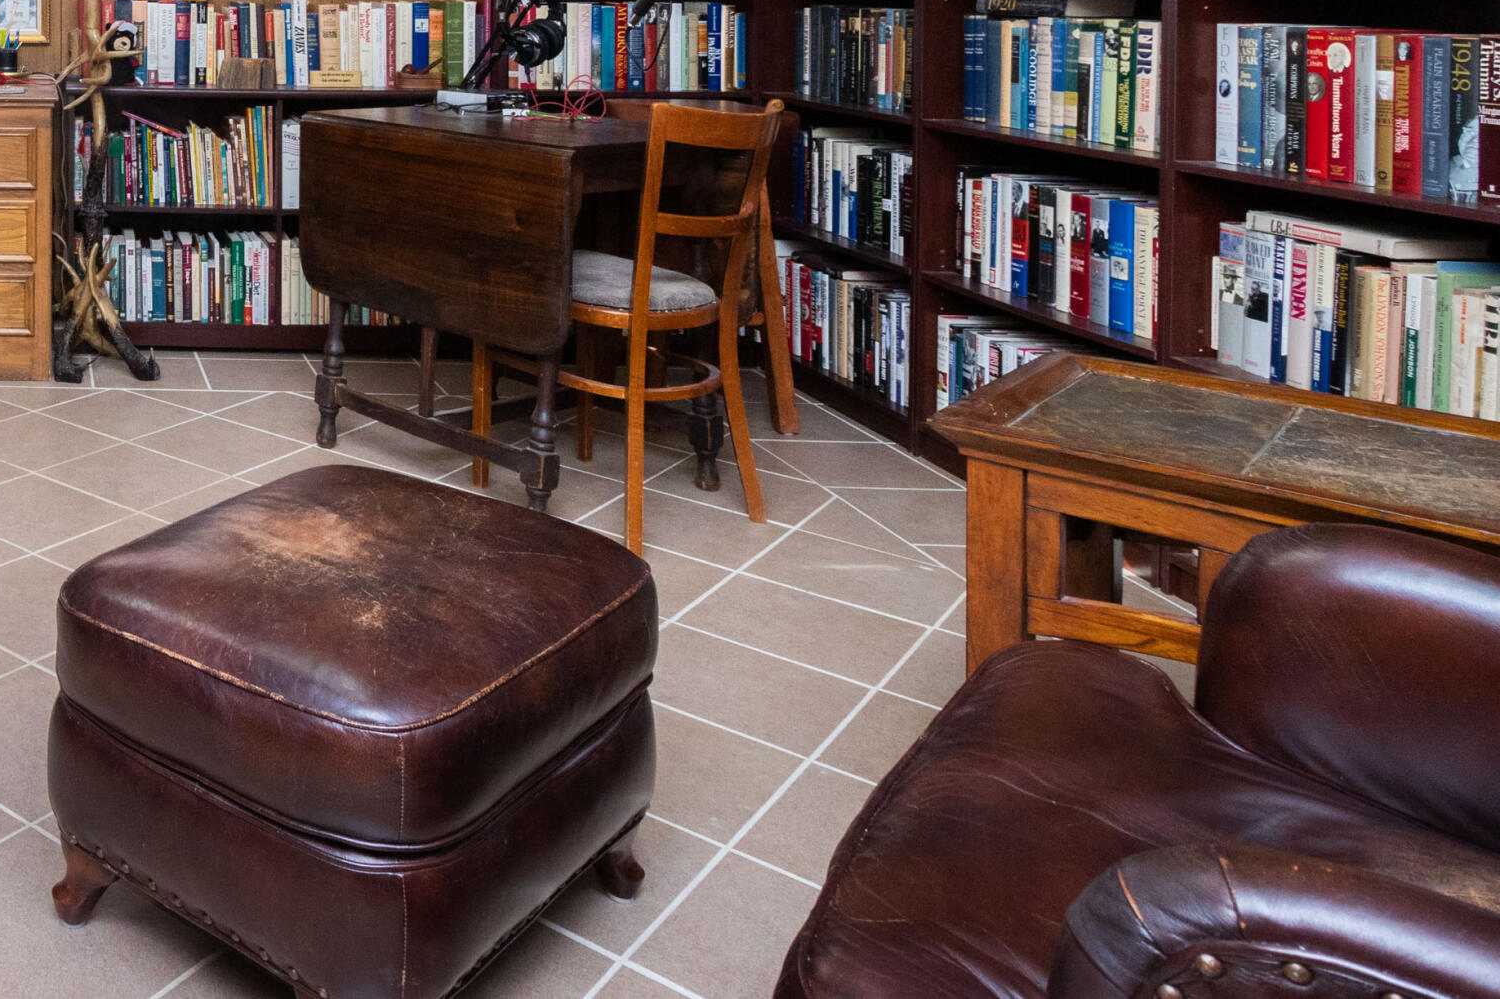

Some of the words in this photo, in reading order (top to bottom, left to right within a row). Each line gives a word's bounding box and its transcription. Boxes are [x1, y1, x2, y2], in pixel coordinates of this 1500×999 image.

[617, 6, 627, 22] MY
[294, 25, 306, 55] ZANIES
[617, 24, 627, 54] TURN
[1137, 28, 1153, 76] FDR
[1028, 48, 1037, 106] COOLIDGE
[1290, 63, 1298, 99] SCORPIONS
[1431, 47, 1444, 77] PLAIN
[1451, 41, 1472, 91] 1948
[1479, 40, 1494, 101] Truman
[1269, 72, 1277, 105] TRAITOR
[1331, 76, 1344, 133] Tumultuous
[1395, 65, 1410, 117] TRUMAN
[1431, 81, 1444, 129] SPEAKING
[1331, 132, 1344, 159] Years
[1275, 239, 1286, 275] TAKING
[1291, 262, 1307, 321] LYNDON
[1373, 278, 1387, 292] The
[1138, 290, 1147, 321] POINT
[1373, 294, 1387, 333] LYNDON
[1373, 336, 1387, 380] JOHNSON
[1407, 338, 1417, 378] JOHNSON
